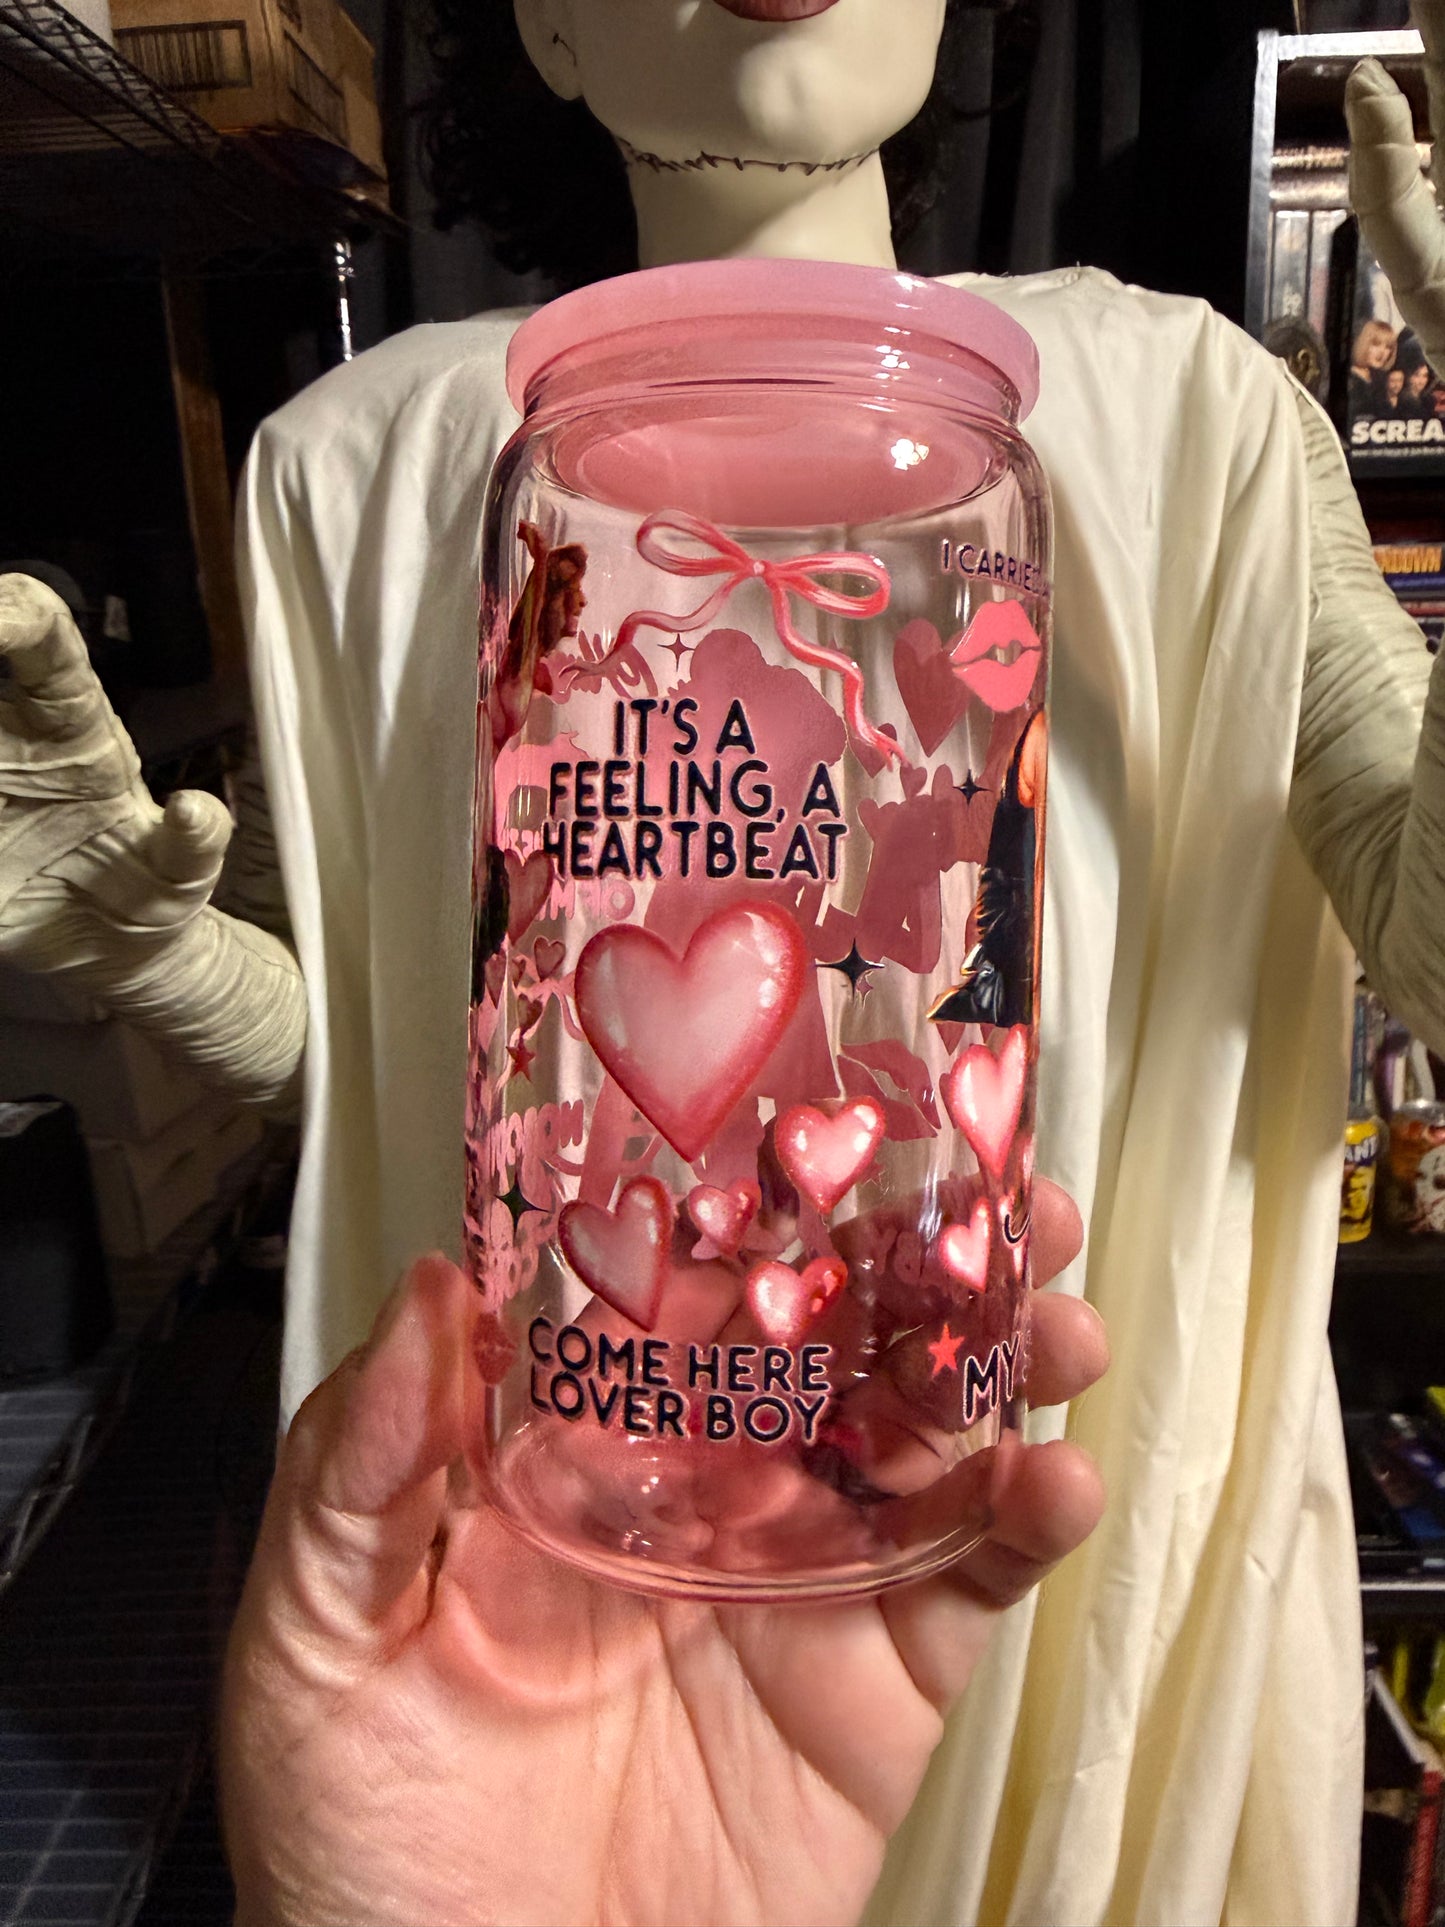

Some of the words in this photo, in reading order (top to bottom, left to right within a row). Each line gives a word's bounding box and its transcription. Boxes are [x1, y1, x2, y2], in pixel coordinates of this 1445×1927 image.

[1350, 418, 1445, 445] SCREA
[613, 698, 700, 756] IT'S
[715, 697, 758, 756] A
[548, 759, 786, 824] FEELING,
[801, 762, 842, 819] A
[543, 821, 850, 882] HEARTBEAT
[528, 1317, 672, 1387] COME
[688, 1345, 834, 1393] HERE
[964, 1335, 1022, 1424] MY
[531, 1371, 688, 1439] LOVER
[706, 1395, 828, 1442] BOY
